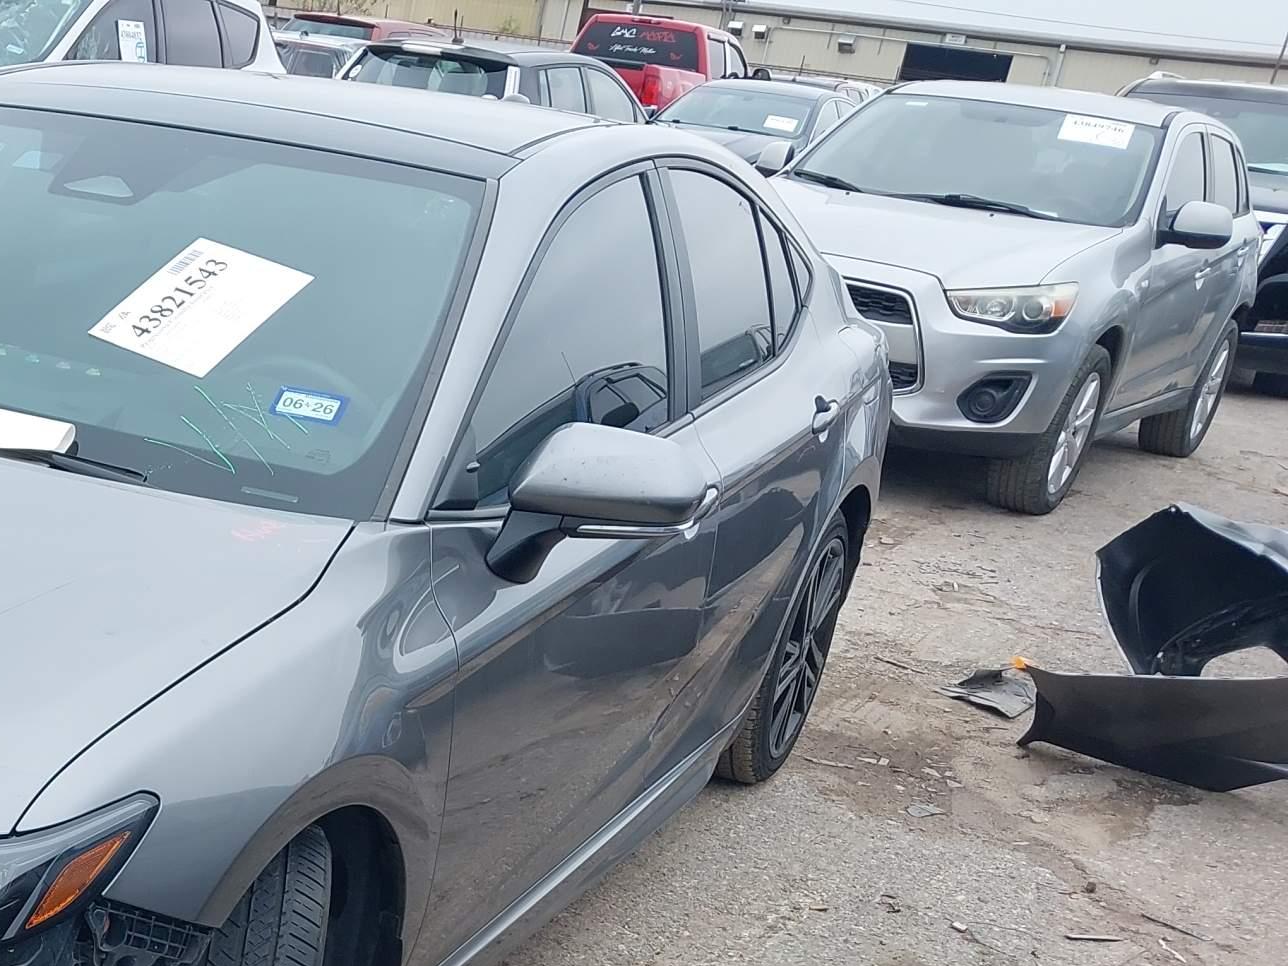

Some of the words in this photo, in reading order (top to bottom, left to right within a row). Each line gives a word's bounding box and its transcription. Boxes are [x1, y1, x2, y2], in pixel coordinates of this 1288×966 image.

[611, 26, 637, 38] GMC
[131, 258, 228, 338] 43821543
[282, 397, 305, 409] 06
[311, 402, 335, 415] 26
